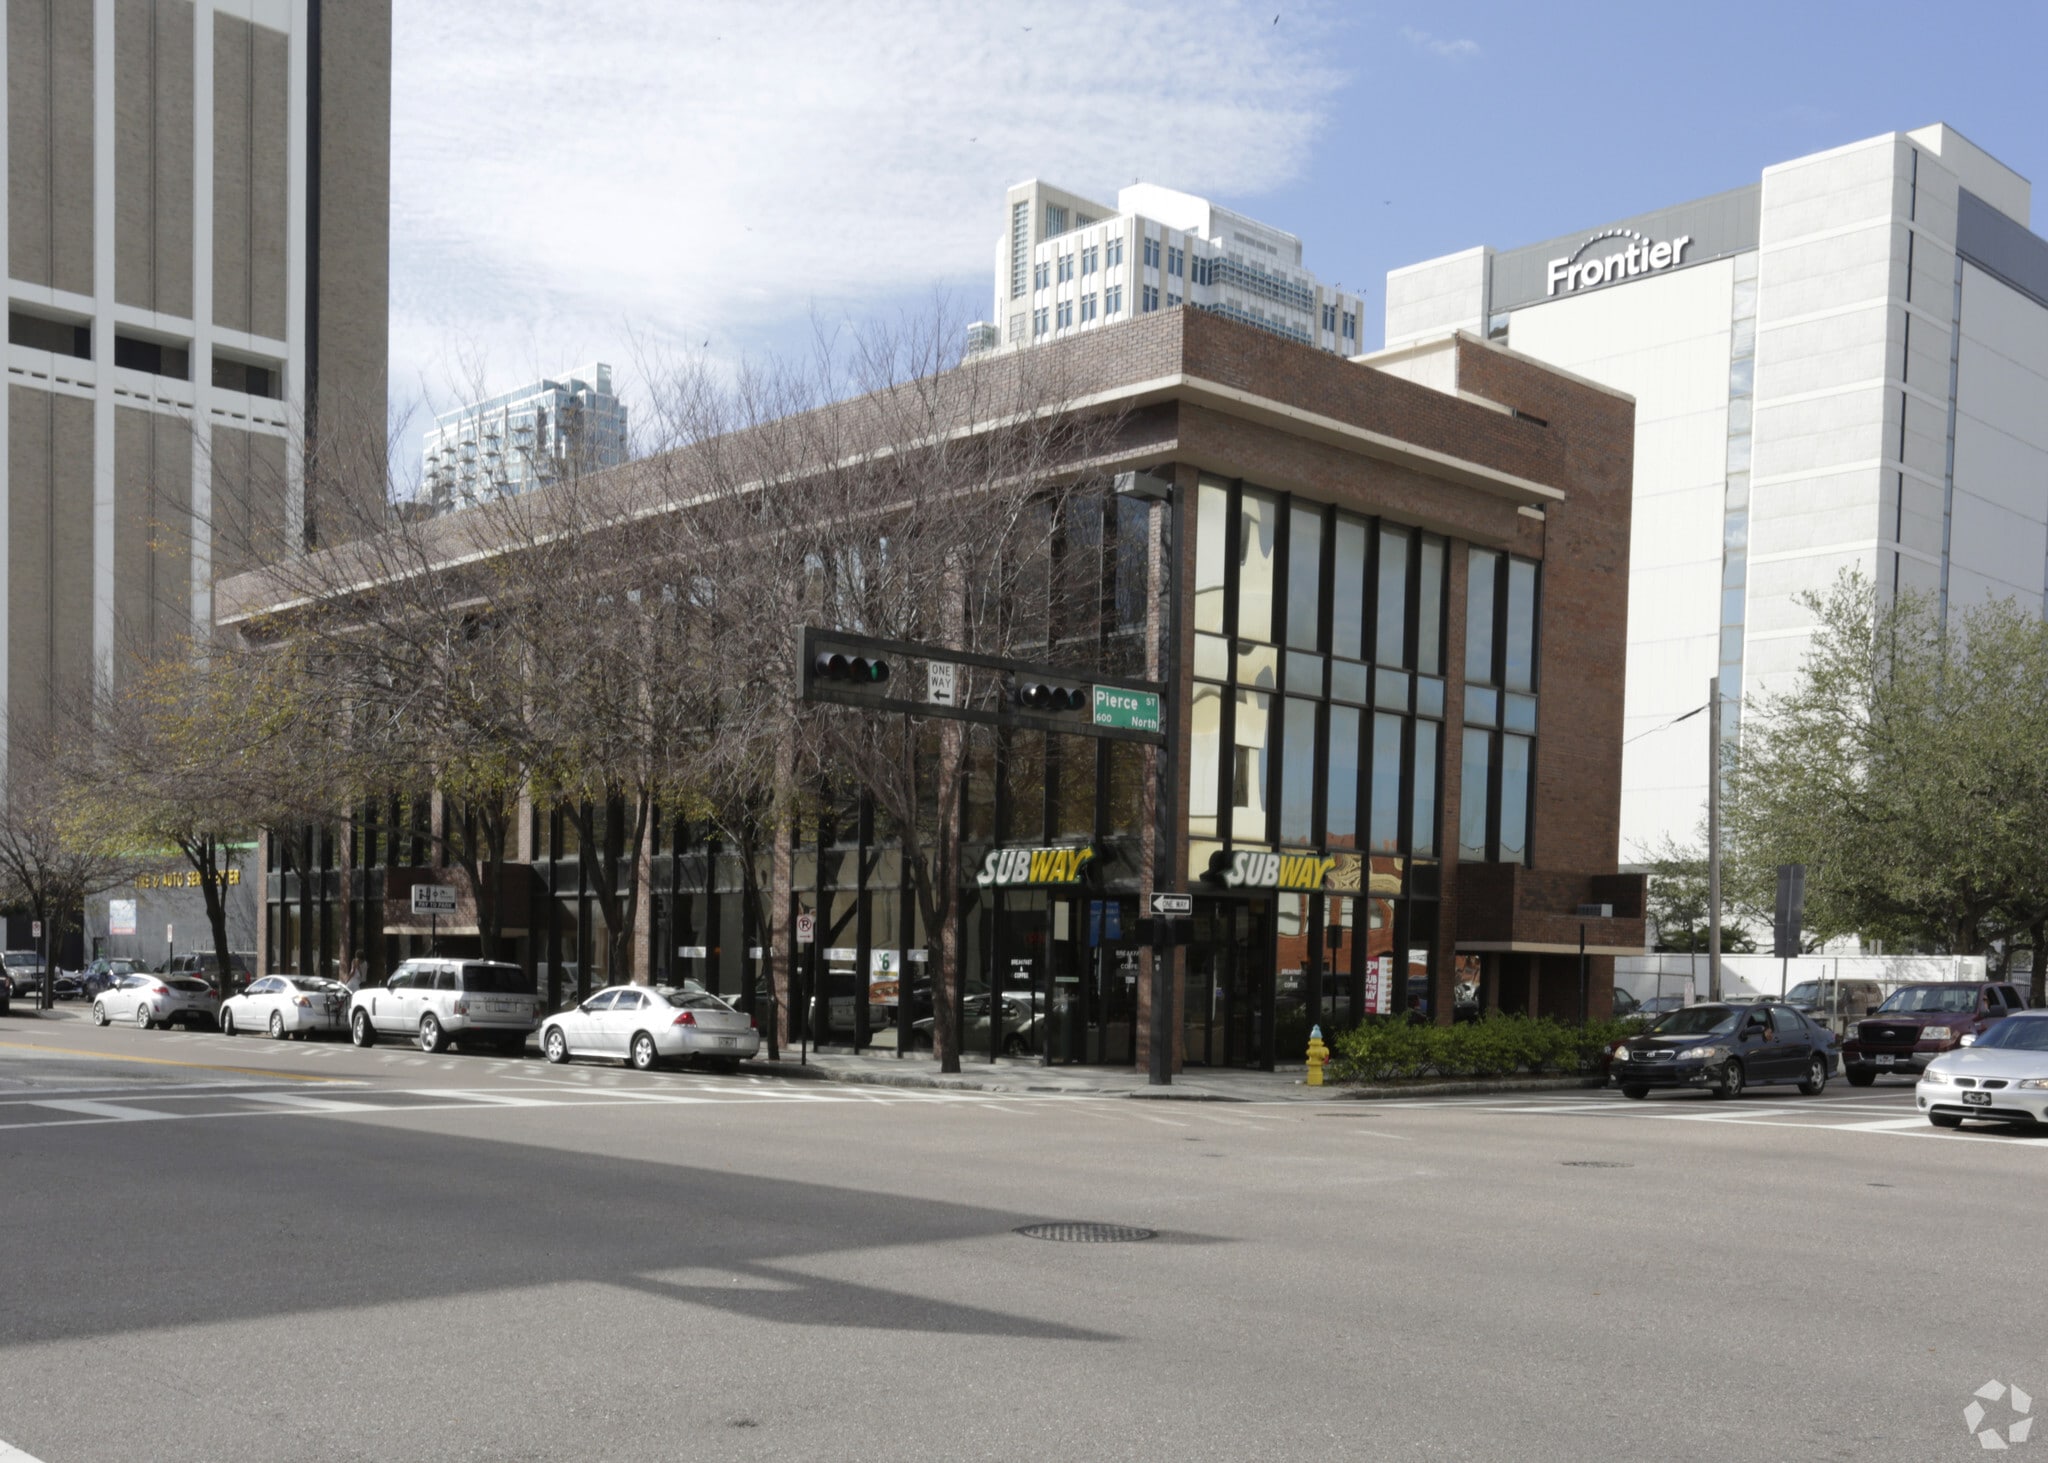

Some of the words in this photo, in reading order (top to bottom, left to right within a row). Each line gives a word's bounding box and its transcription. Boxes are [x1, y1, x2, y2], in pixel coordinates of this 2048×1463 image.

[1547, 234, 1689, 296] Frontier
[932, 664, 951, 677] ONE
[931, 676, 951, 688] WAY
[1096, 690, 1138, 710] Pierce
[1145, 697, 1156, 706] ST
[1096, 713, 1112, 723] 600
[1131, 716, 1157, 729] North
[976, 846, 1093, 887] SUBWAY
[1224, 851, 1336, 889] SUBWAY
[163, 871, 184, 888] AUTO
[1162, 900, 1173, 908] ONE
